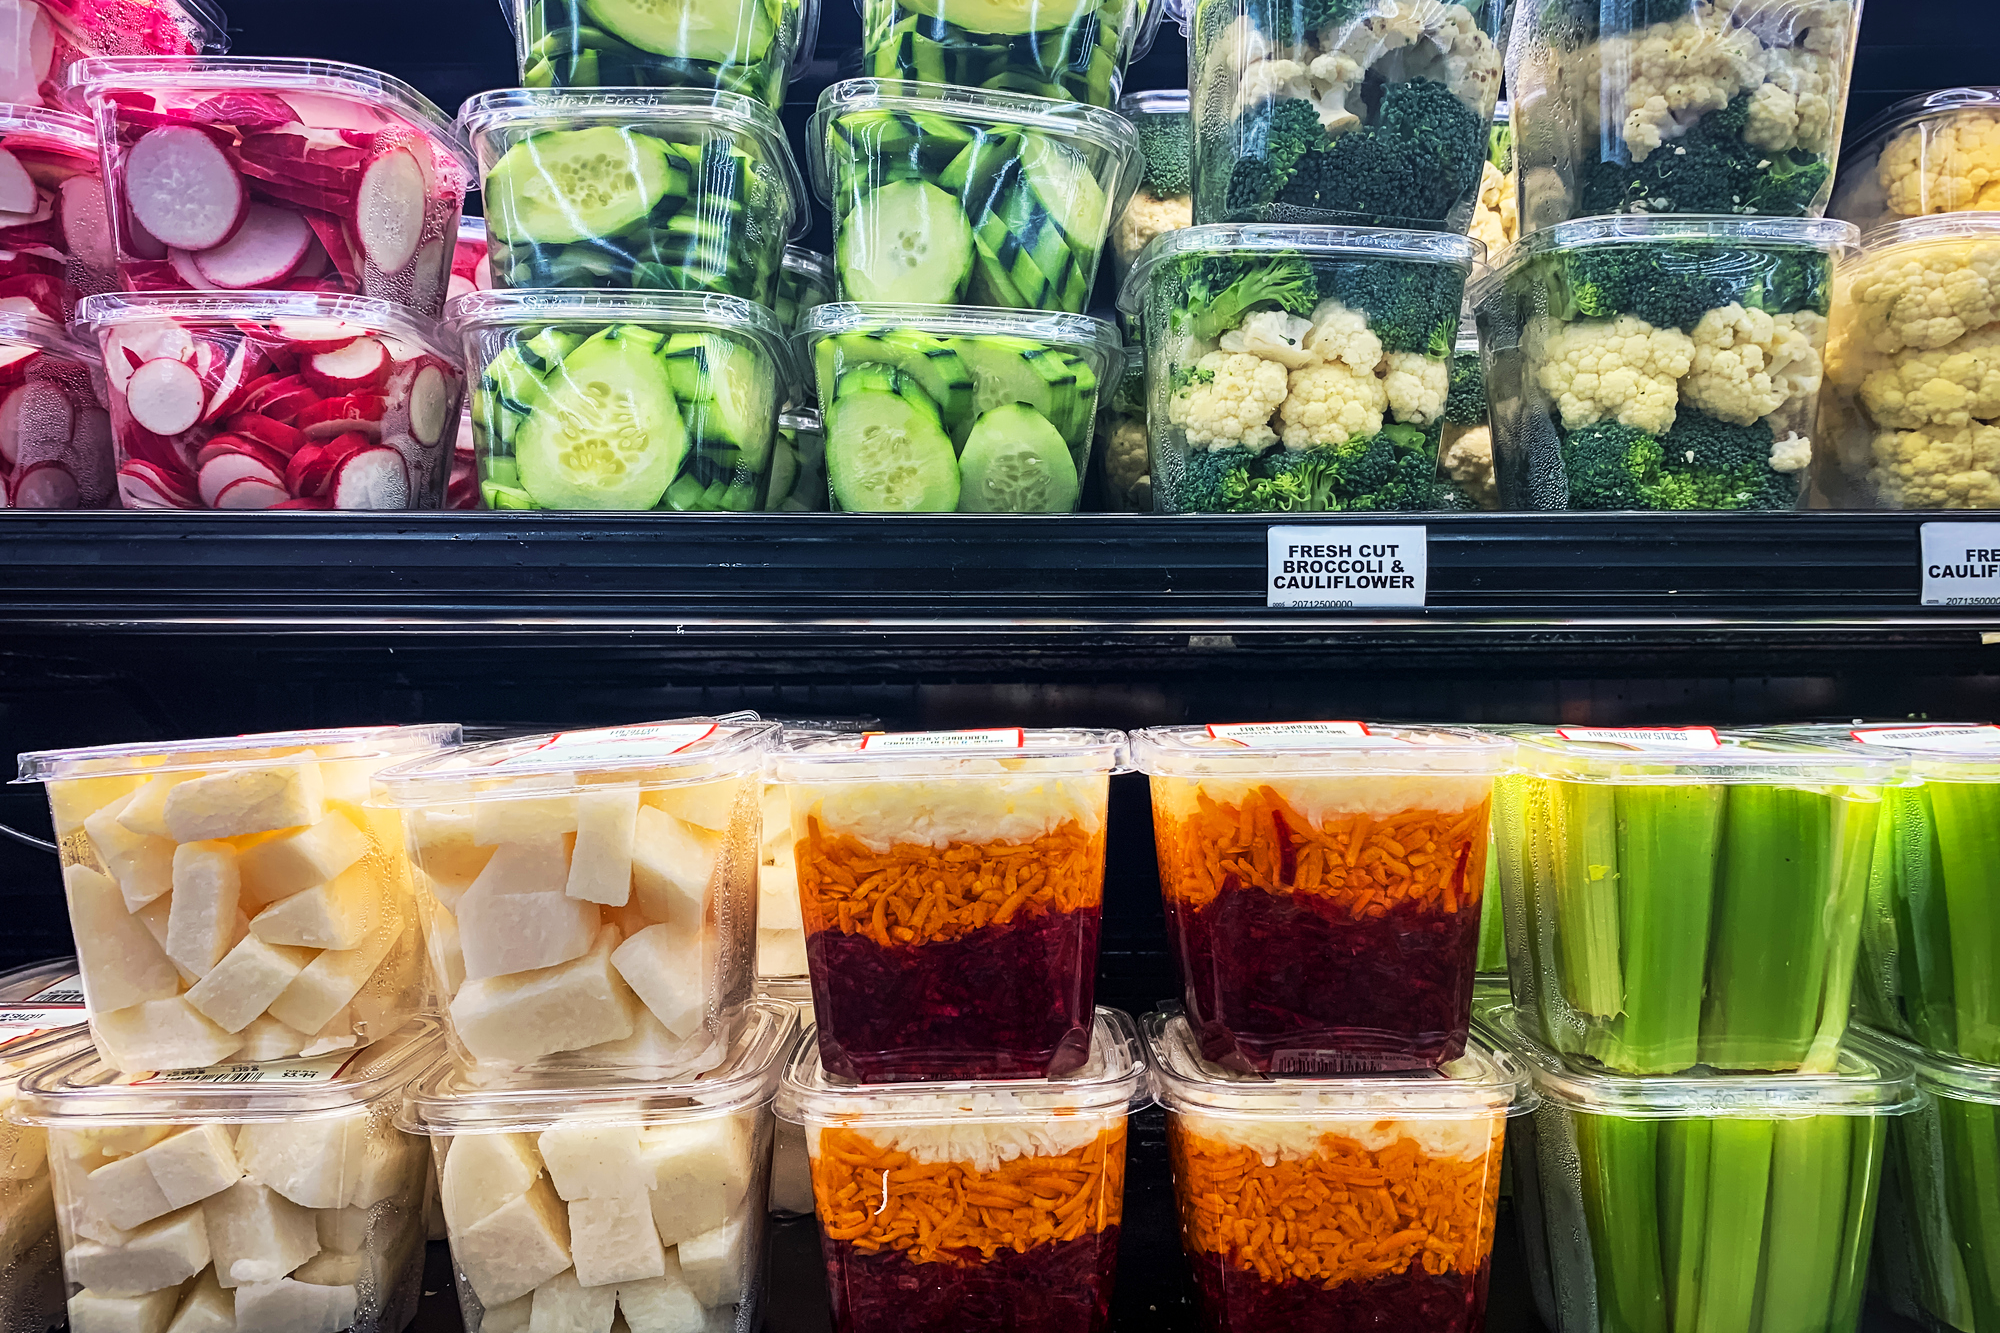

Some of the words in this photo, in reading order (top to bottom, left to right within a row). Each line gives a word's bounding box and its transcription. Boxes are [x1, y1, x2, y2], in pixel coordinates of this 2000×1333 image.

[1288, 545, 1352, 558] FRESH
[1359, 544, 1399, 557] CUT
[1283, 560, 1383, 573] BROCCOLI
[1391, 560, 1405, 573] &
[1928, 565, 2000, 578] CAULIF
[1273, 576, 1415, 589] CAULIFLOWER
[1292, 600, 1353, 608] 20712500000
[1587, 731, 1618, 739] FRESH
[1619, 731, 1652, 740] CELERY
[1653, 732, 1688, 741] STICKS
